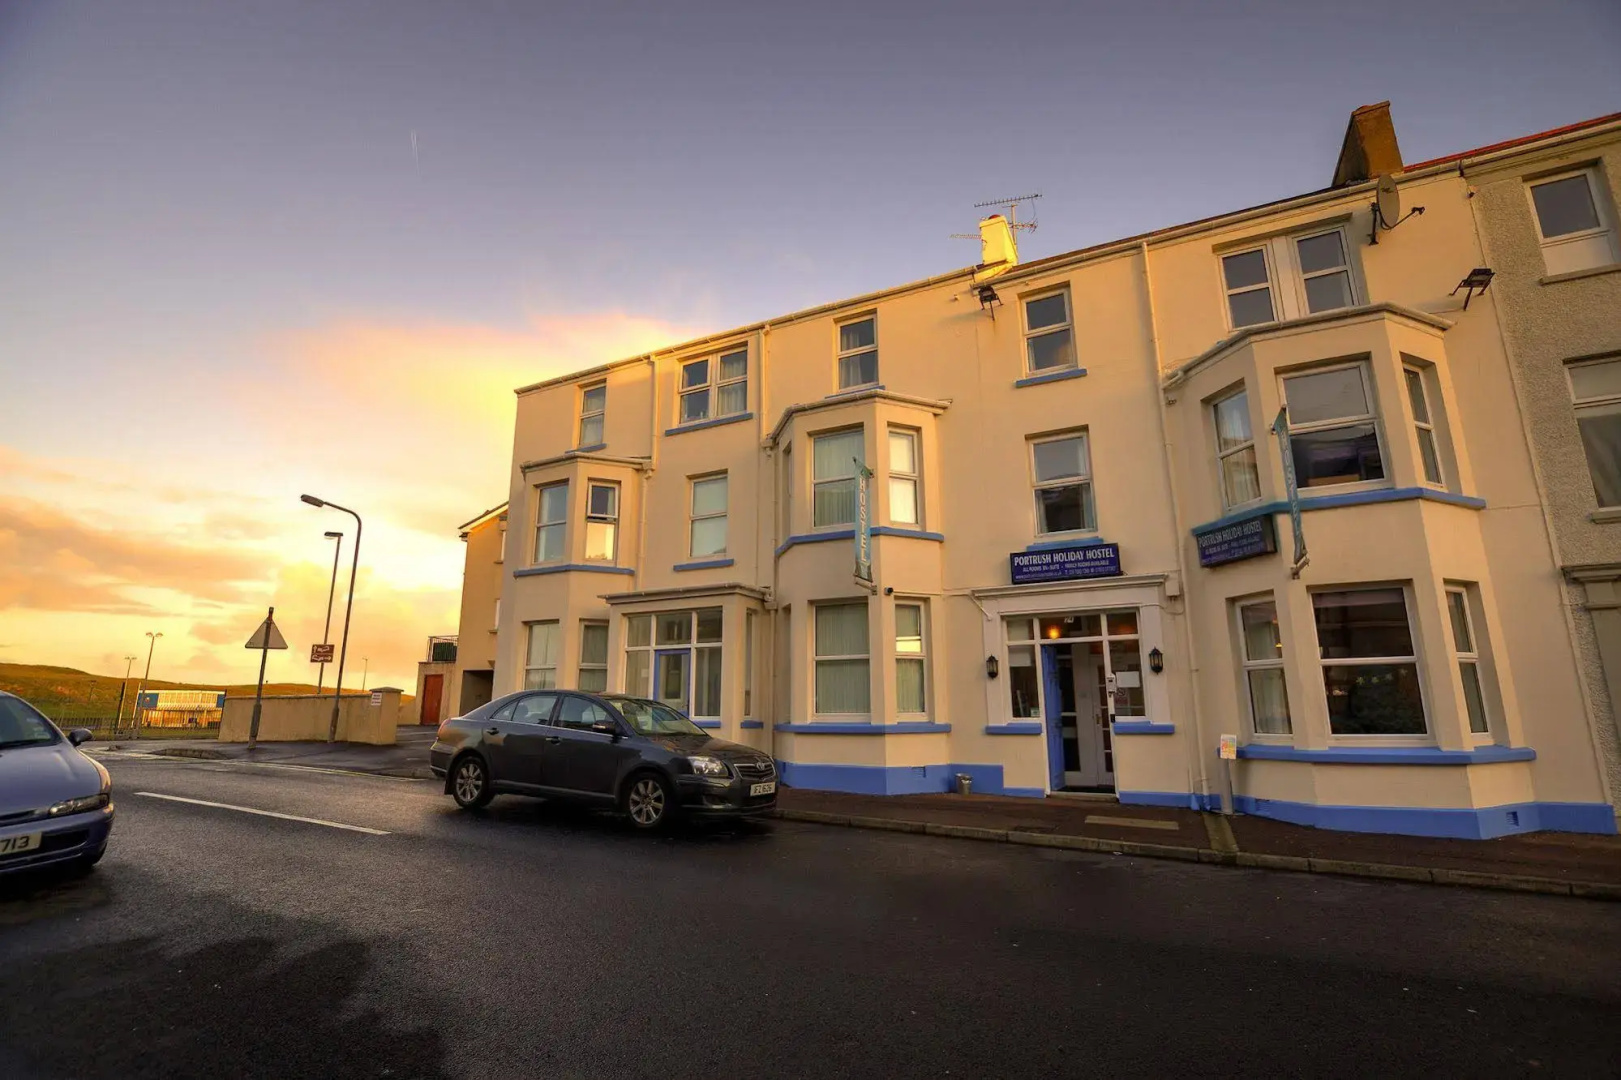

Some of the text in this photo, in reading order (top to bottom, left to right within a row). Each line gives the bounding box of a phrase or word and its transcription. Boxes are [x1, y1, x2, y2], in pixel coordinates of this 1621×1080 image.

[1281, 429, 1300, 537] HOSTEL
[858, 475, 868, 563] HOSTEL
[1198, 531, 1223, 548] PORTRUSH
[1222, 526, 1243, 541] HOLIDAY
[1243, 520, 1263, 534] HOSTEL
[1014, 547, 1115, 566] PORTRUSH HOLIDAY HOSTEL
[0, 835, 30, 852] 713
